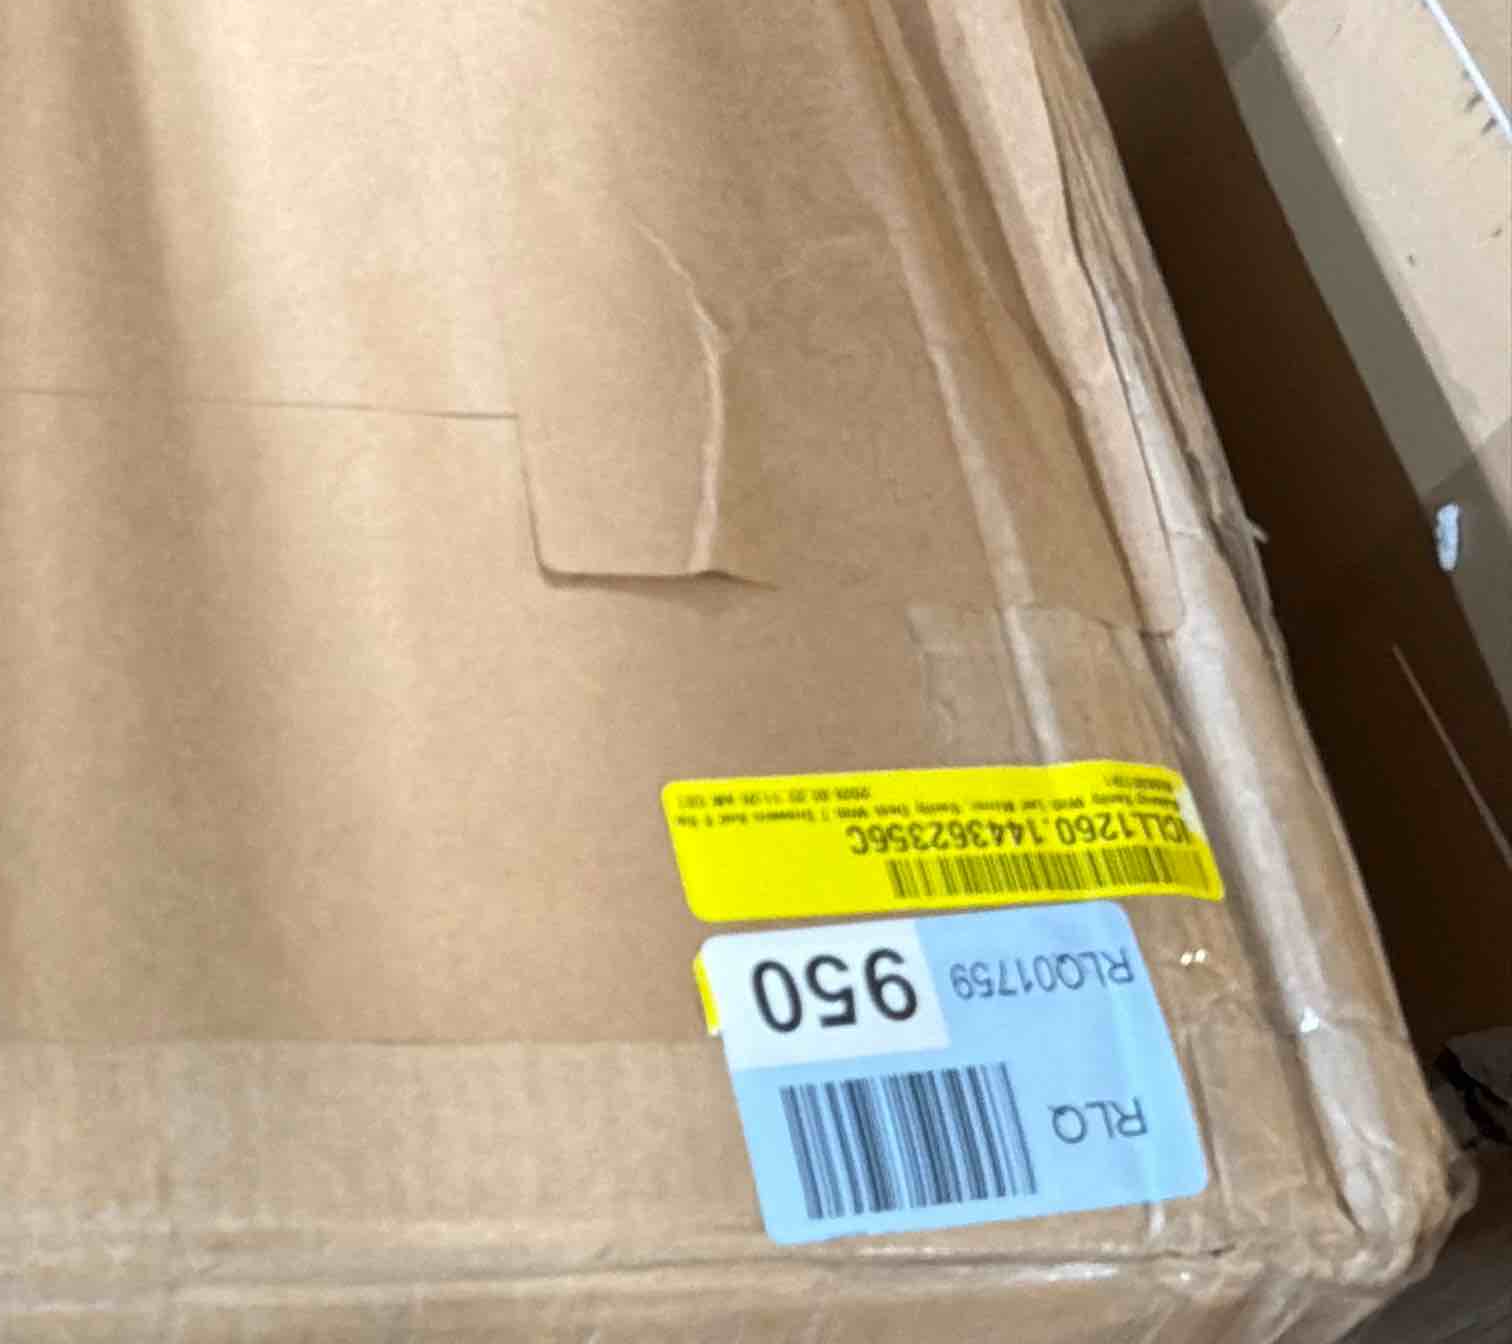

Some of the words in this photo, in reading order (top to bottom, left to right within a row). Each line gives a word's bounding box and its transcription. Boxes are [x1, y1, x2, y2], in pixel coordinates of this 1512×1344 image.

[750, 947, 919, 1033] 950
[951, 947, 1136, 1002] RLQ01759
[1048, 1096, 1149, 1146] RLQ
